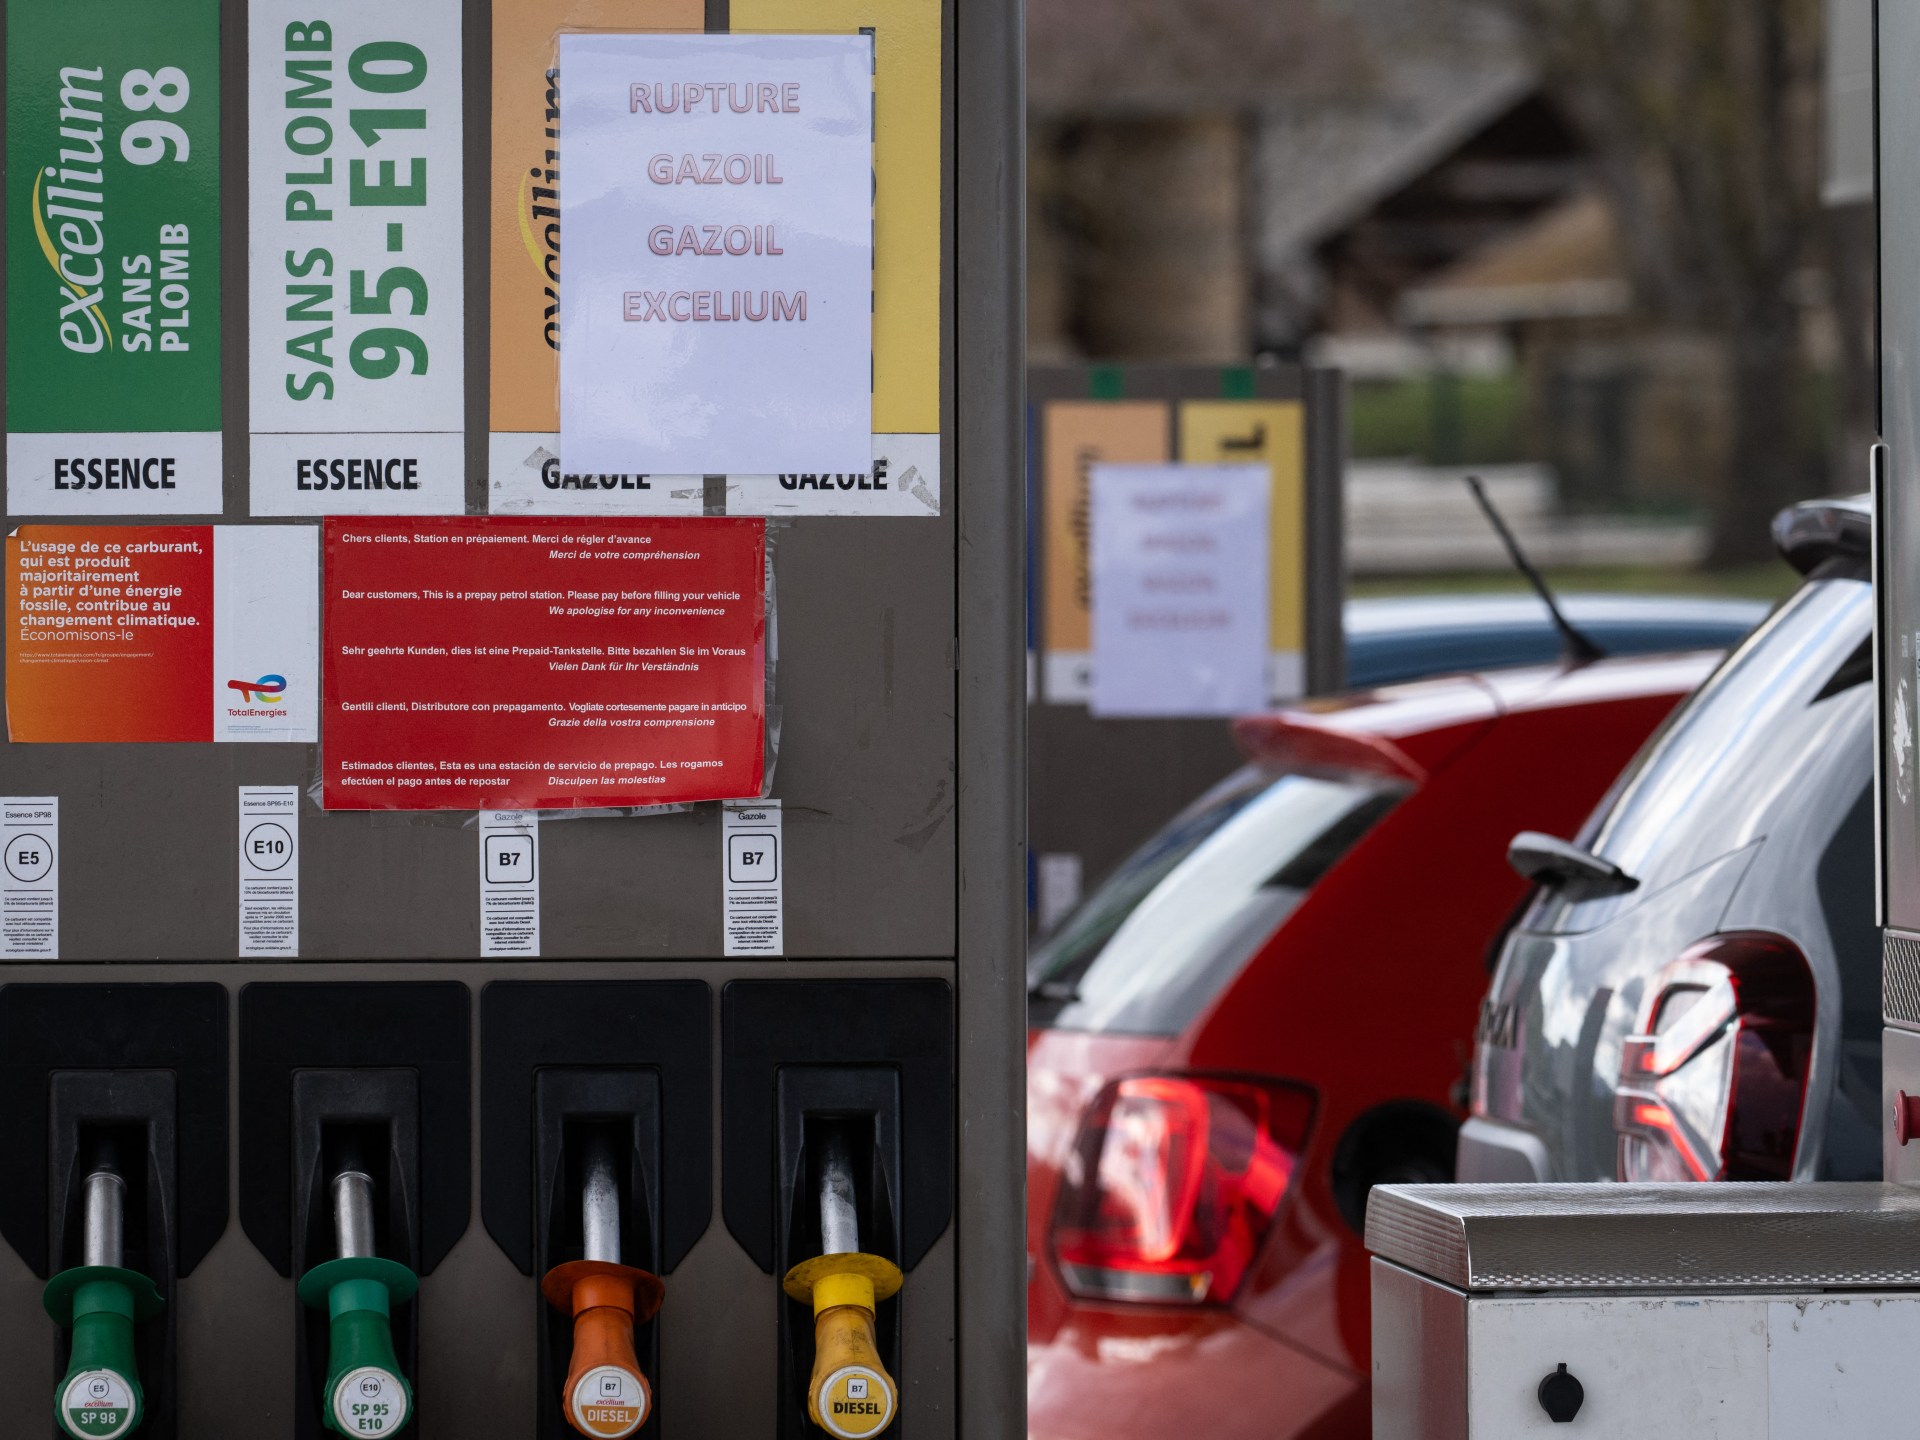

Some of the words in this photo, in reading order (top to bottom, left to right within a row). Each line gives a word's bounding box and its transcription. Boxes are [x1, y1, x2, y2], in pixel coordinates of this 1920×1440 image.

[630, 83, 800, 113] RUPTURE
[120, 66, 190, 166] 98
[286, 19, 333, 222] PLOMB
[648, 154, 783, 185] GAZOIL
[47, 66, 104, 354] excellium
[348, 40, 429, 380] 95-E10
[648, 225, 783, 256] GAZOIL
[160, 223, 190, 352] PLOMB
[122, 254, 152, 352] SANS
[624, 291, 806, 321] EXCELIUM
[285, 247, 334, 401] SANS
[55, 458, 175, 489] ESSENCE
[297, 459, 418, 490] ESSENCE
[342, 533, 372, 543] Chers
[374, 534, 411, 544] clients,
[413, 533, 449, 543] Station
[466, 534, 530, 545] prépaiement.
[532, 534, 559, 544] Merci
[561, 534, 574, 544] de
[576, 534, 605, 546] régler
[607, 534, 652, 544] d'avance
[21, 541, 75, 554] L'usage
[81, 542, 99, 552] de
[104, 544, 121, 553] ce
[126, 542, 202, 554] carburant,
[20, 555, 42, 568] qui
[48, 556, 70, 566] est
[75, 556, 129, 569] produit
[549, 550, 577, 559] Merci
[579, 550, 592, 559] de
[594, 551, 620, 559] votre
[622, 550, 700, 561] compréhension
[20, 570, 139, 583] majoritairement
[20, 584, 28, 596] à
[34, 585, 74, 598] partir
[79, 585, 120, 596] d'une
[126, 585, 181, 598] énergie
[342, 589, 365, 599] Dear
[366, 590, 421, 601] customers,
[422, 590, 444, 599] This
[445, 590, 455, 599] is
[464, 592, 498, 601] prepay
[499, 590, 528, 601] petrol
[529, 590, 565, 600] station.
[567, 590, 600, 600] Please
[601, 592, 619, 602] pay
[621, 590, 652, 600] before
[653, 590, 681, 602] filling
[682, 592, 705, 602] your
[706, 591, 741, 600] vehicle
[20, 599, 71, 613] fossile,
[76, 600, 147, 611] contribue
[549, 605, 565, 615] We
[566, 606, 615, 617] apologise
[617, 606, 632, 615] for
[633, 608, 652, 617] any
[653, 606, 725, 616] inconvenience
[20, 614, 112, 628] changement
[118, 614, 199, 627] climatique.
[21, 626, 133, 640] Économisons-le
[341, 645, 366, 655] Sehr
[367, 646, 405, 657] geehrte
[407, 646, 449, 657] Kunden,
[450, 646, 472, 655] dies
[474, 646, 487, 655] ist
[488, 646, 510, 655] eine
[512, 646, 605, 657] Prepaid-Tankstelle.
[607, 646, 631, 656] Bitte
[632, 646, 677, 656] bezahlen
[679, 646, 695, 656] Sie
[697, 646, 710, 656] im
[711, 646, 746, 656] Voraus
[549, 661, 579, 671] Vielen
[581, 661, 607, 671] Dank
[609, 661, 624, 671] für
[625, 662, 640, 671] Ihr
[641, 662, 699, 671] Verständnis
[228, 708, 287, 718] TotalEnergies
[341, 701, 374, 711] Gentili
[376, 702, 409, 712] clienti,
[411, 702, 470, 711] Distributore
[492, 702, 566, 713] prepagamento.
[568, 702, 605, 714] Vogliate
[605, 703, 667, 711] cortesemente
[668, 704, 700, 714] pagare
[700, 702, 710, 711] in
[710, 702, 747, 713] anticipo
[548, 717, 581, 727] Grazie
[583, 717, 607, 727] della
[610, 718, 641, 727] vostra
[643, 717, 716, 729] comprensione
[341, 761, 394, 770] Estimados
[396, 761, 437, 771] clientes,
[439, 761, 462, 770] Esta
[498, 761, 541, 770] estación
[543, 761, 556, 770] de
[558, 761, 597, 770] servicio
[599, 760, 612, 770] de
[614, 762, 658, 772] prepago.
[660, 760, 678, 769] Les
[680, 760, 724, 770] rogamos
[341, 776, 384, 786] efectúen
[386, 776, 395, 786] el
[397, 778, 423, 788] pago
[424, 777, 452, 786] antes
[454, 776, 467, 786] de
[469, 777, 511, 788] repostar
[548, 776, 598, 787] Disculpen
[600, 776, 616, 785] las
[617, 775, 666, 784] molestias
[5, 811, 33, 819] Essence
[494, 812, 523, 821] Gazole
[736, 811, 767, 820] Gazole
[254, 840, 284, 854] E10
[18, 851, 40, 865] E5
[499, 852, 521, 866] B7
[742, 851, 764, 866] B7
[93, 1385, 105, 1393] E5
[360, 1382, 378, 1392] E10
[605, 1383, 617, 1391] B7
[851, 1385, 863, 1393] B7
[84, 1400, 114, 1408] excellium
[352, 1403, 370, 1416] SP
[373, 1403, 389, 1416] 95
[834, 1403, 880, 1414] DIESEL
[81, 1411, 97, 1424] SP
[99, 1412, 117, 1424] 98
[585, 1409, 633, 1424] DIESEL
[358, 1418, 383, 1430] E10
